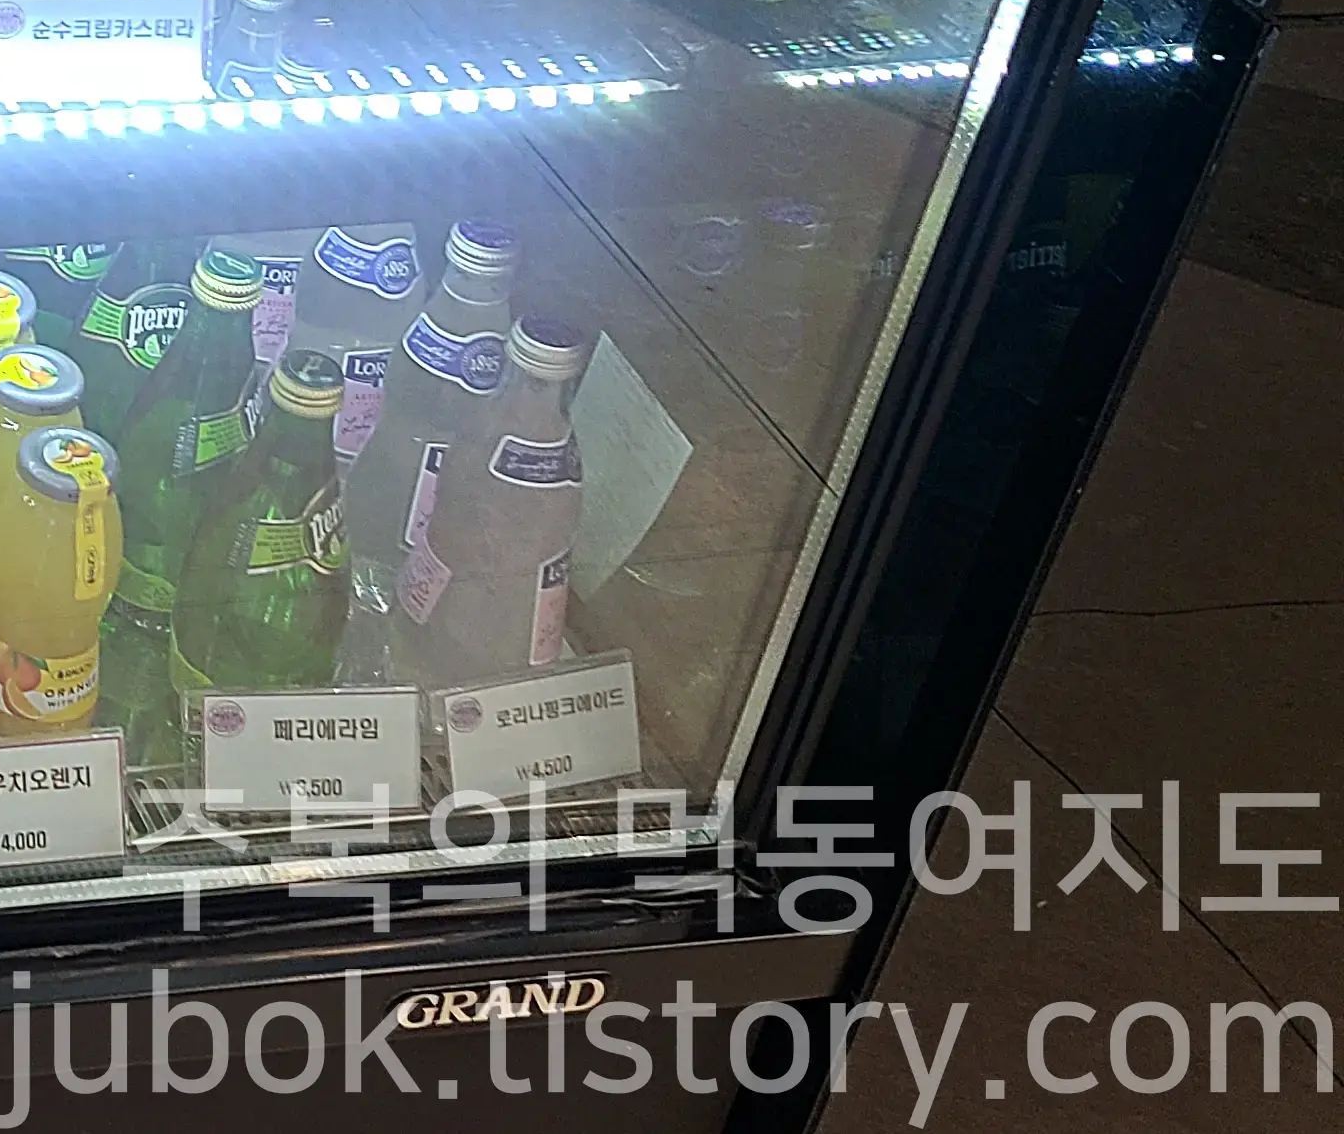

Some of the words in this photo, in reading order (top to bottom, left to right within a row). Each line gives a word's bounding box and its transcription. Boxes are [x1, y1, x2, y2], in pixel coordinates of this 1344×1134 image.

[32, 19, 194, 40] 순수크림카스테라
[495, 687, 626, 728] 로리나핑크에이드
[397, 978, 605, 1029] GRAND
